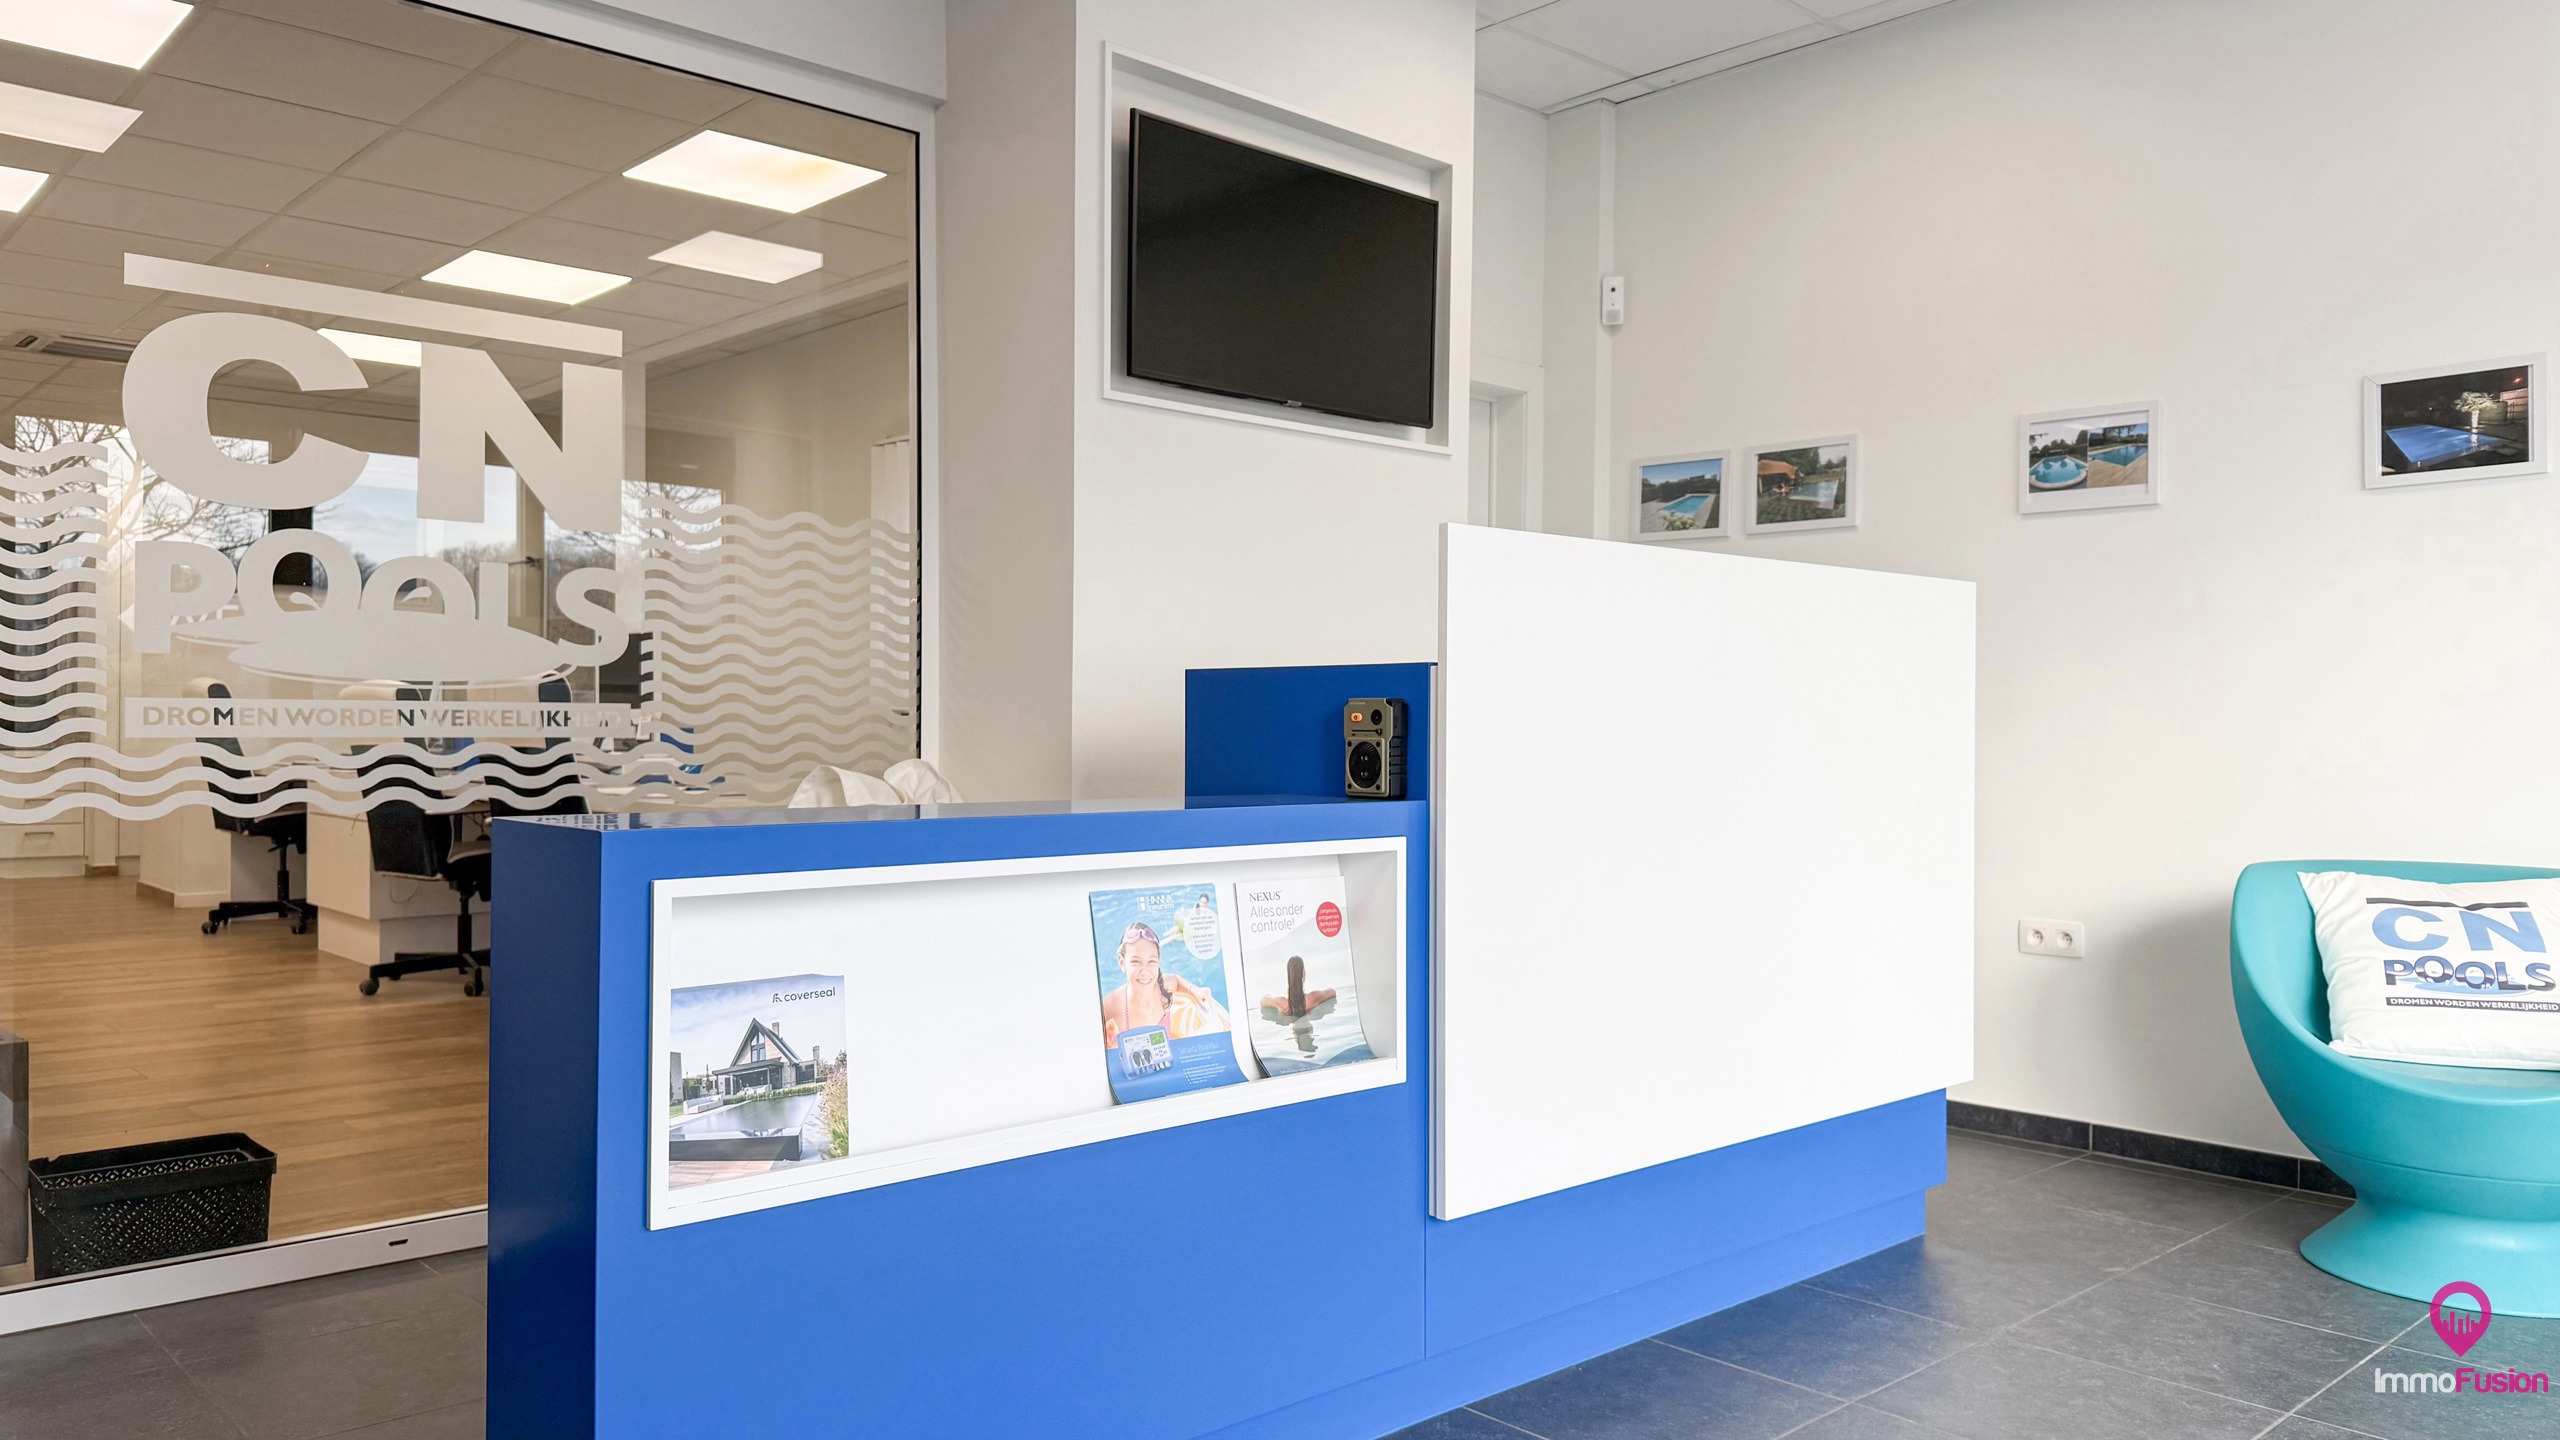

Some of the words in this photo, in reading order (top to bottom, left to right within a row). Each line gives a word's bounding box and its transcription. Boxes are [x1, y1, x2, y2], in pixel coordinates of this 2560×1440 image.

[122, 312, 622, 533] CN
[132, 528, 629, 667] POOLS
[142, 706, 278, 727] DROMEN
[284, 706, 415, 728] WORDEN
[1250, 905, 1275, 918] Alles
[1275, 903, 1304, 917] onder
[1251, 918, 1295, 933] controle!
[2372, 907, 2547, 953] CN
[2383, 955, 2556, 992] POOLS
[783, 986, 836, 1002] coverseal
[2390, 998, 2434, 1006] DROMEN
[2434, 999, 2480, 1008] WORDEN
[2480, 1001, 2559, 1011] WERKELIJKHEID
